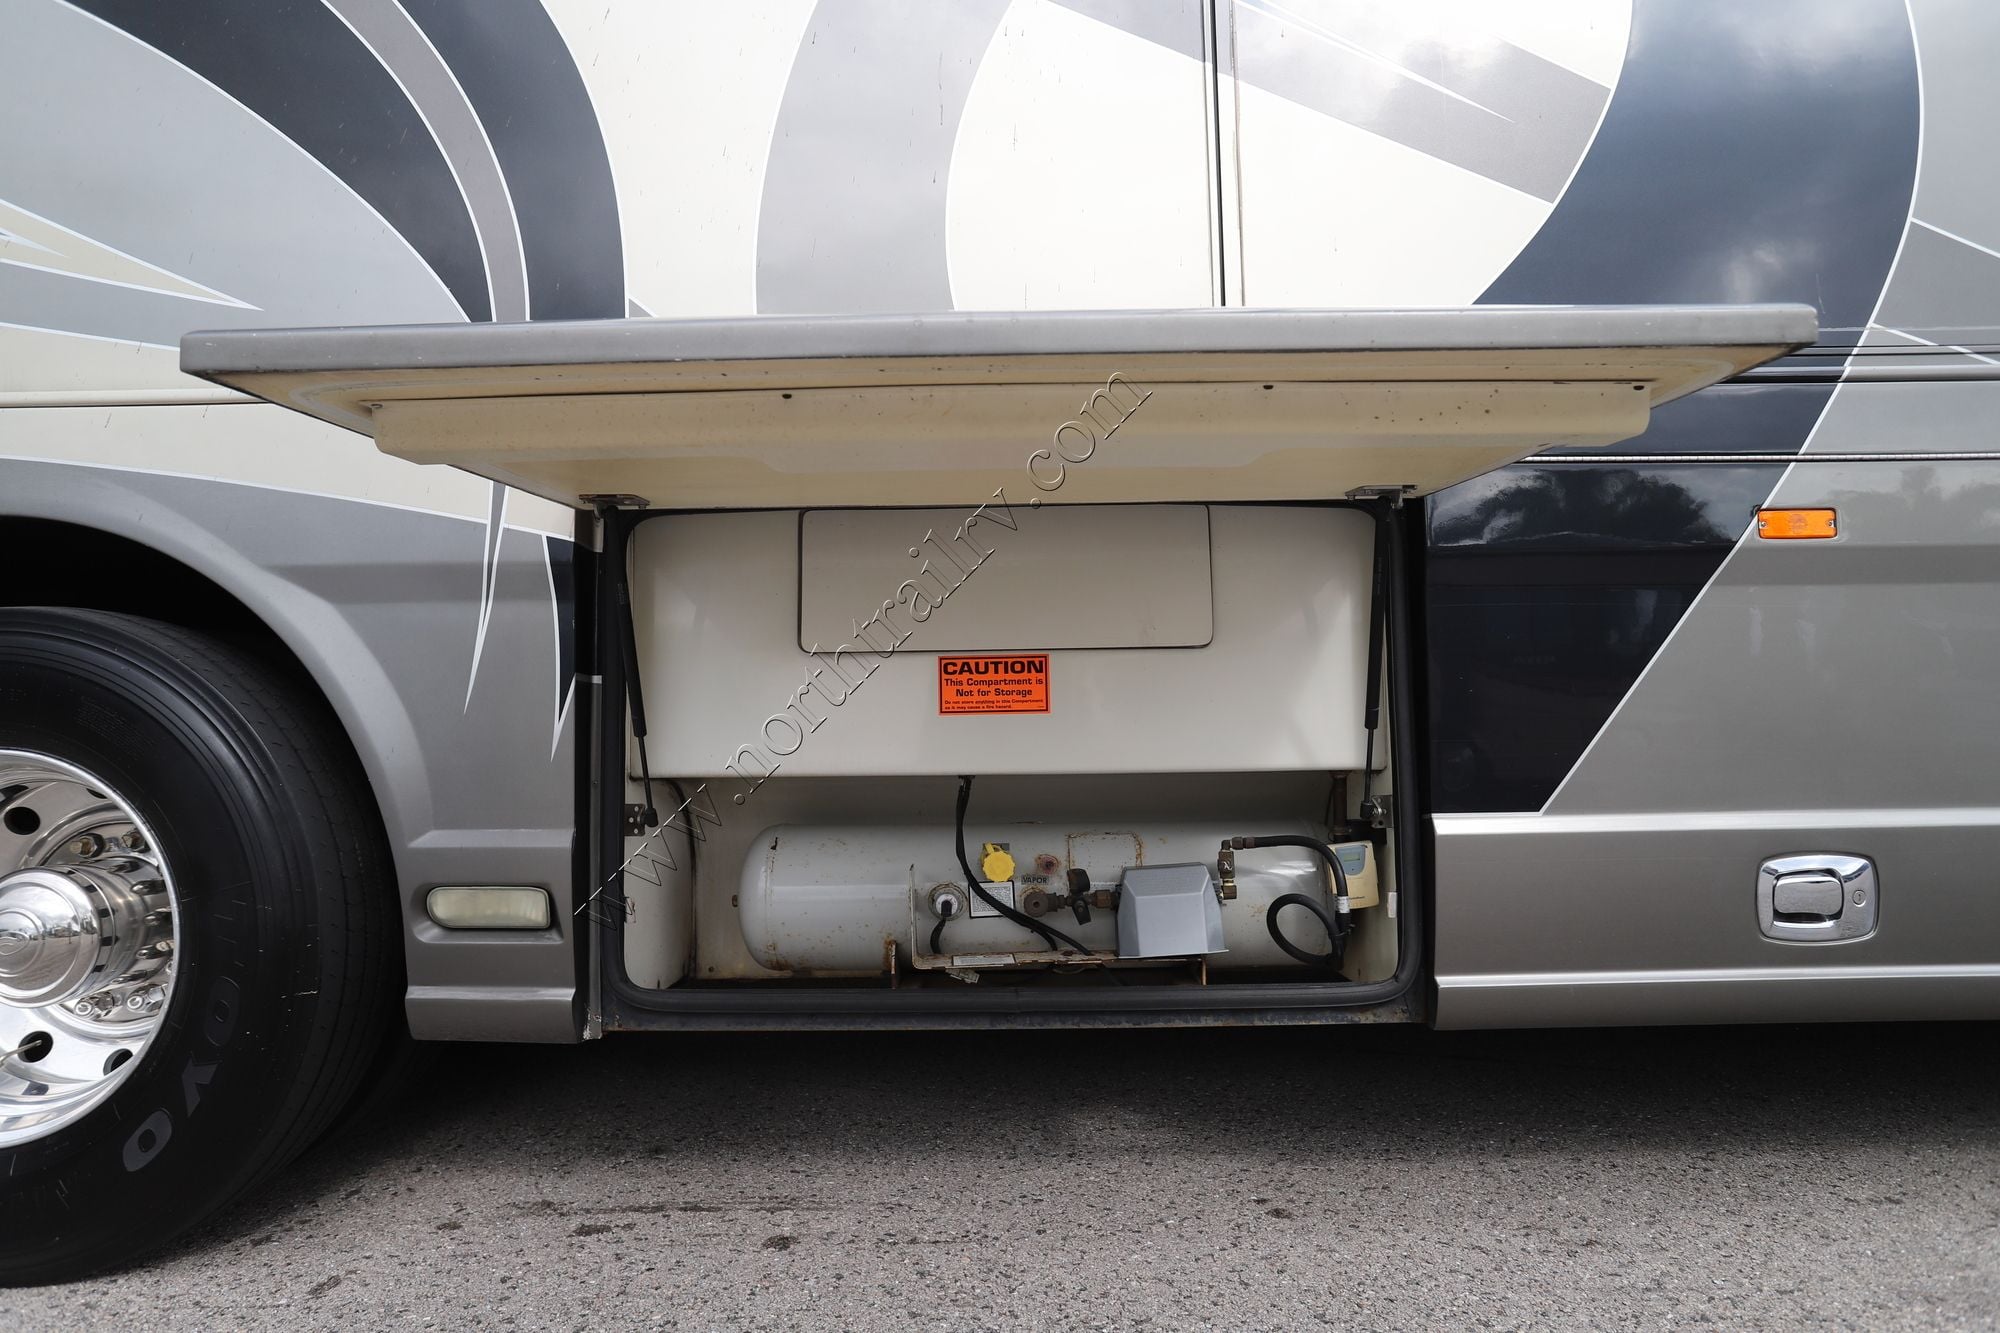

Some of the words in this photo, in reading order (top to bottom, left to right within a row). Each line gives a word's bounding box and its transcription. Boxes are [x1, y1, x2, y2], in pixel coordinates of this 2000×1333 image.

[943, 660, 1044, 675] CAUTION
[944, 678, 963, 686] This
[966, 677, 1033, 688] Compartment
[1035, 677, 1043, 685] is
[956, 689, 974, 697] Not
[977, 688, 991, 696] for
[994, 688, 1033, 698] Storage
